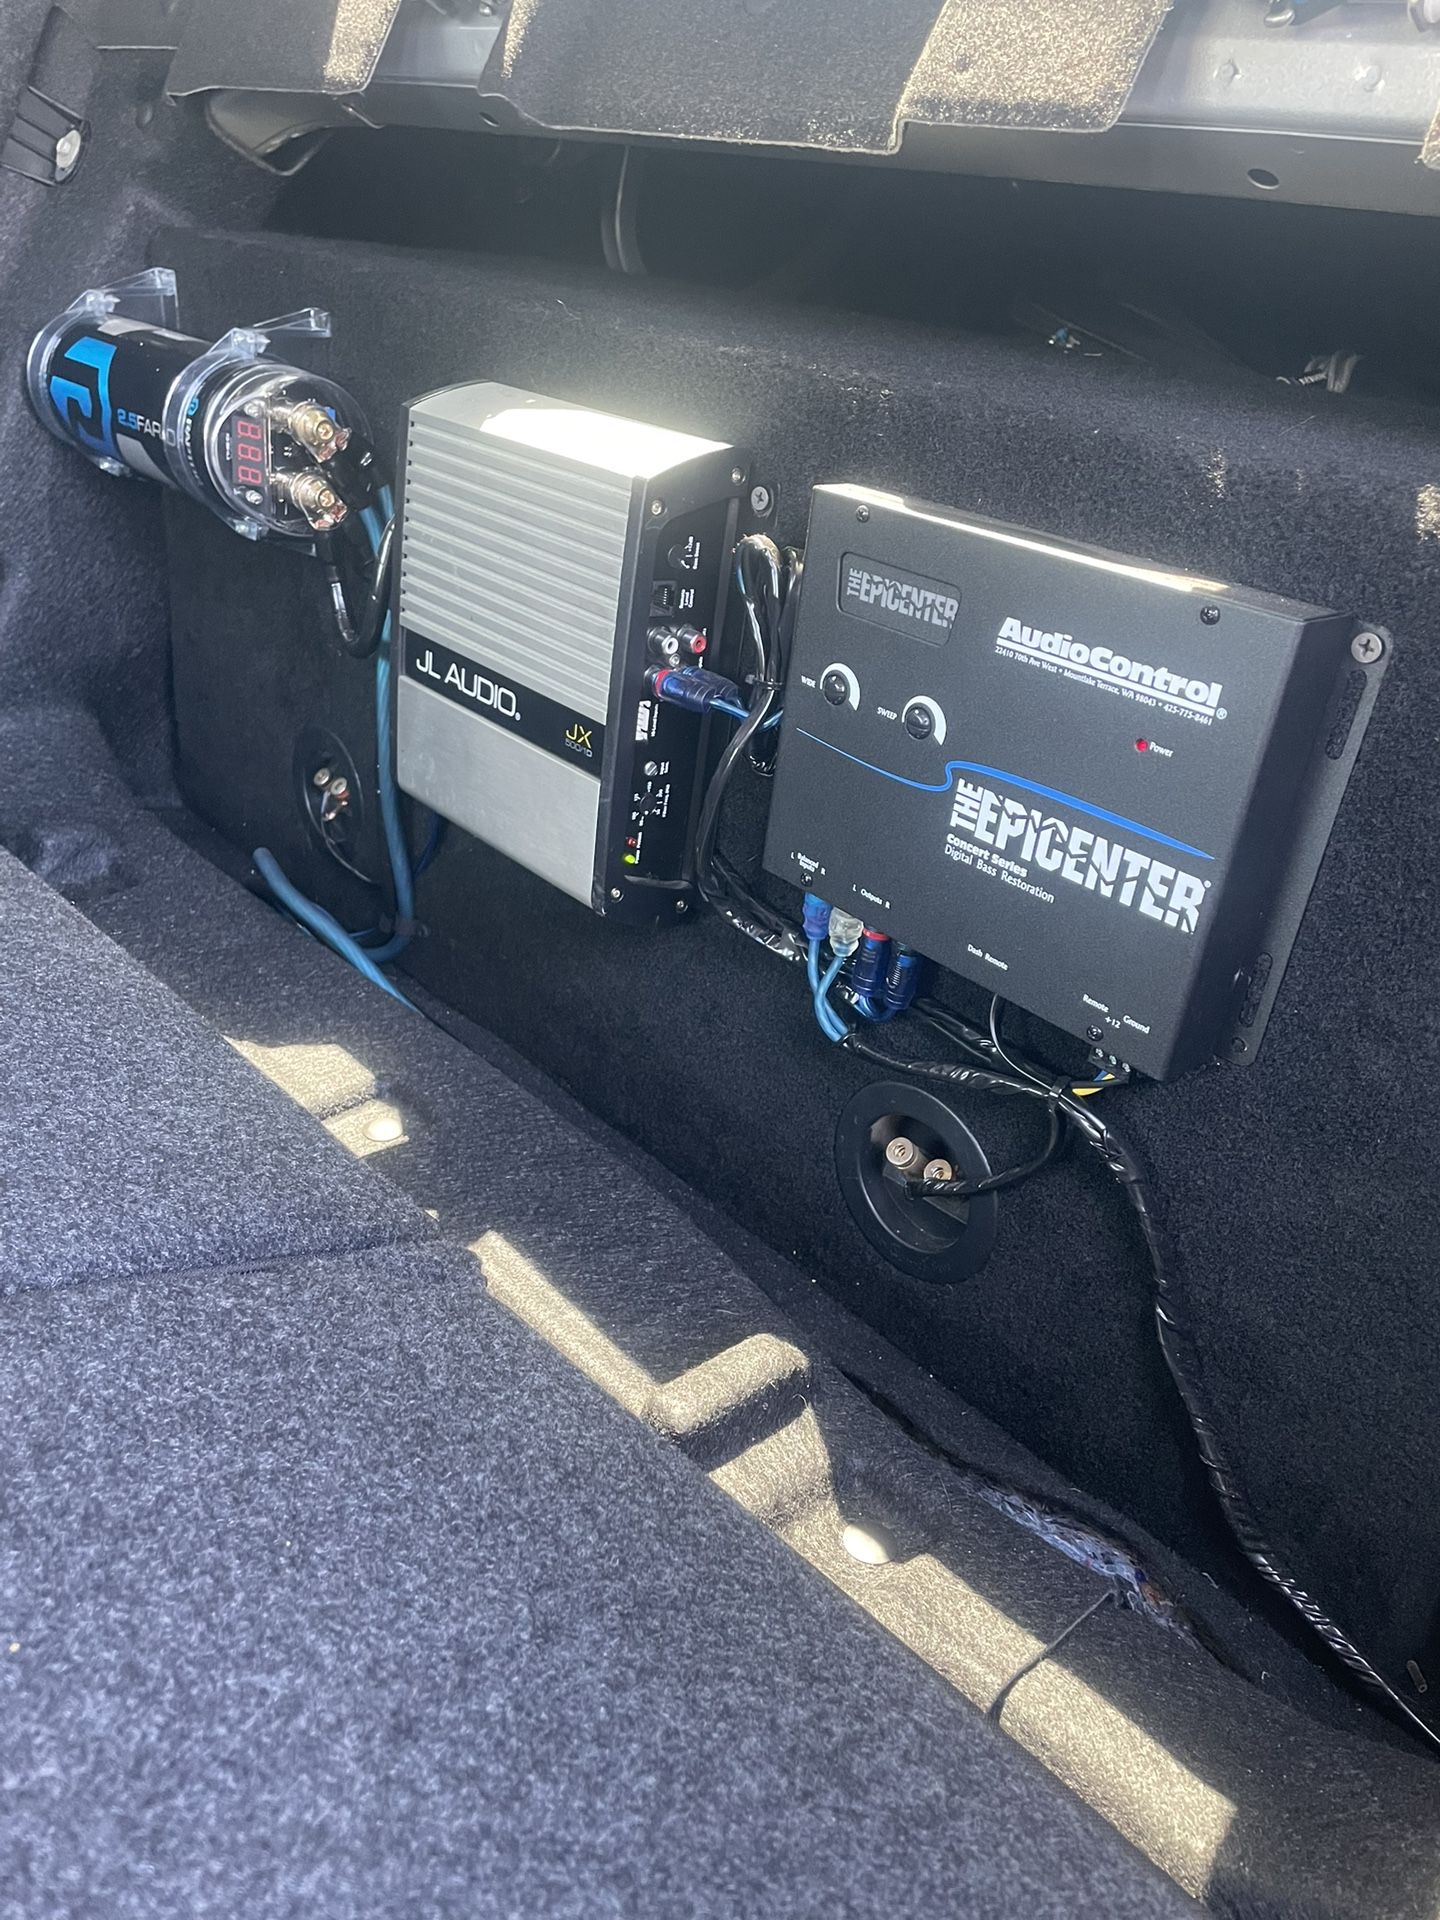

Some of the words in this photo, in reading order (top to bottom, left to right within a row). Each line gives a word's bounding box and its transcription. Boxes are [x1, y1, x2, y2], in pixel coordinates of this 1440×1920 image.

[846, 567, 863, 597] THE
[859, 571, 959, 629] EPICENTER
[416, 650, 442, 680] JL
[998, 616, 1223, 708] AudioControl
[1014, 651, 1028, 664] 70th
[1029, 656, 1041, 668] Ave
[1041, 661, 1058, 673] West
[1063, 668, 1096, 687] Mountlake
[1121, 688, 1134, 700] WA
[801, 674, 817, 688] WIDE
[876, 706, 898, 720] SWEEP
[565, 723, 593, 749] JX
[1149, 741, 1174, 758] Power
[949, 778, 984, 832] THE
[944, 843, 974, 866] Digital
[976, 858, 998, 877] Bass
[1000, 871, 1055, 904] Restoration
[974, 788, 1206, 935] EPICENTER
[861, 889, 883, 905] Outputs
[967, 943, 983, 958] Dash
[985, 952, 1009, 971] Remote
[1082, 993, 1109, 1013] Remote
[1104, 1016, 1121, 1029] +12
[1123, 1014, 1151, 1034] Ground
